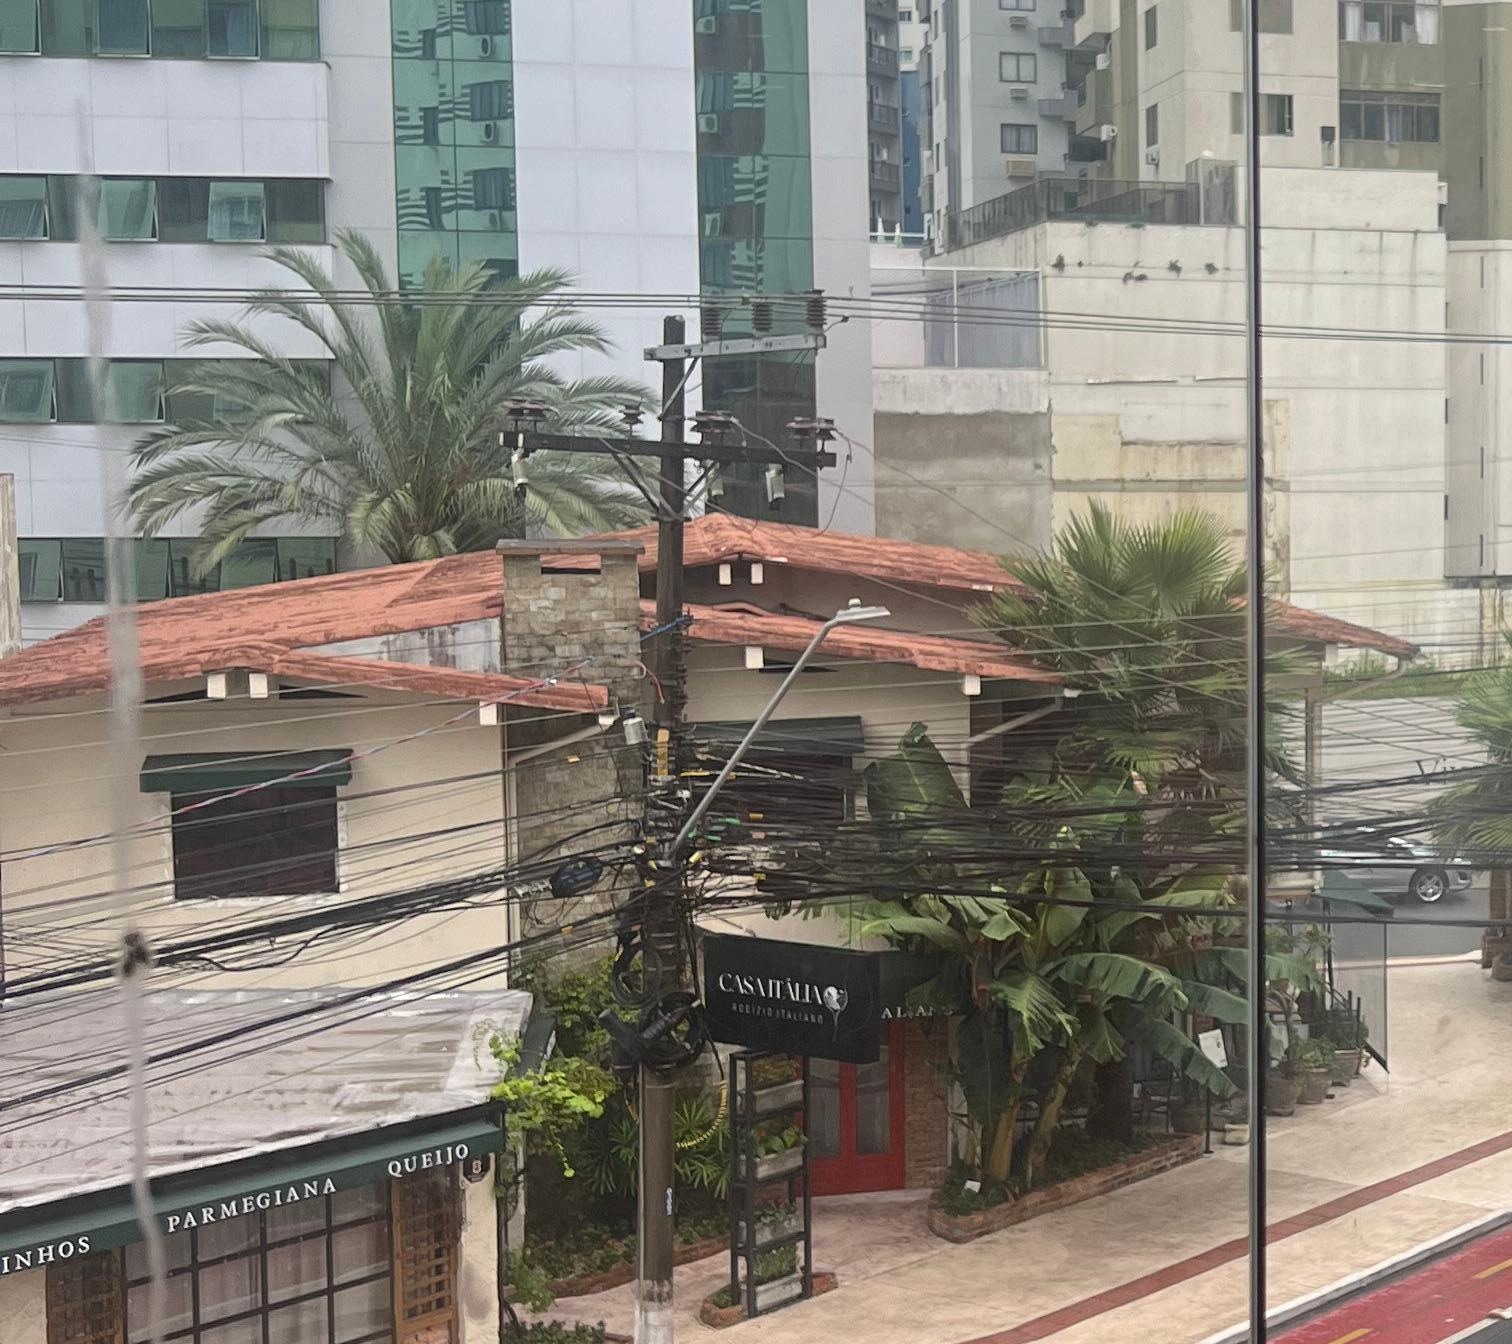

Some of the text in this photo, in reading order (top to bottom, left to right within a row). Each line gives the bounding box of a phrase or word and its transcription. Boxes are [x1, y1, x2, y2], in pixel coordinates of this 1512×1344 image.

[1, 1236, 90, 1274] INHOS
[166, 1177, 337, 1233] PARMEGIANA
[387, 1143, 469, 1178] QUEIJO
